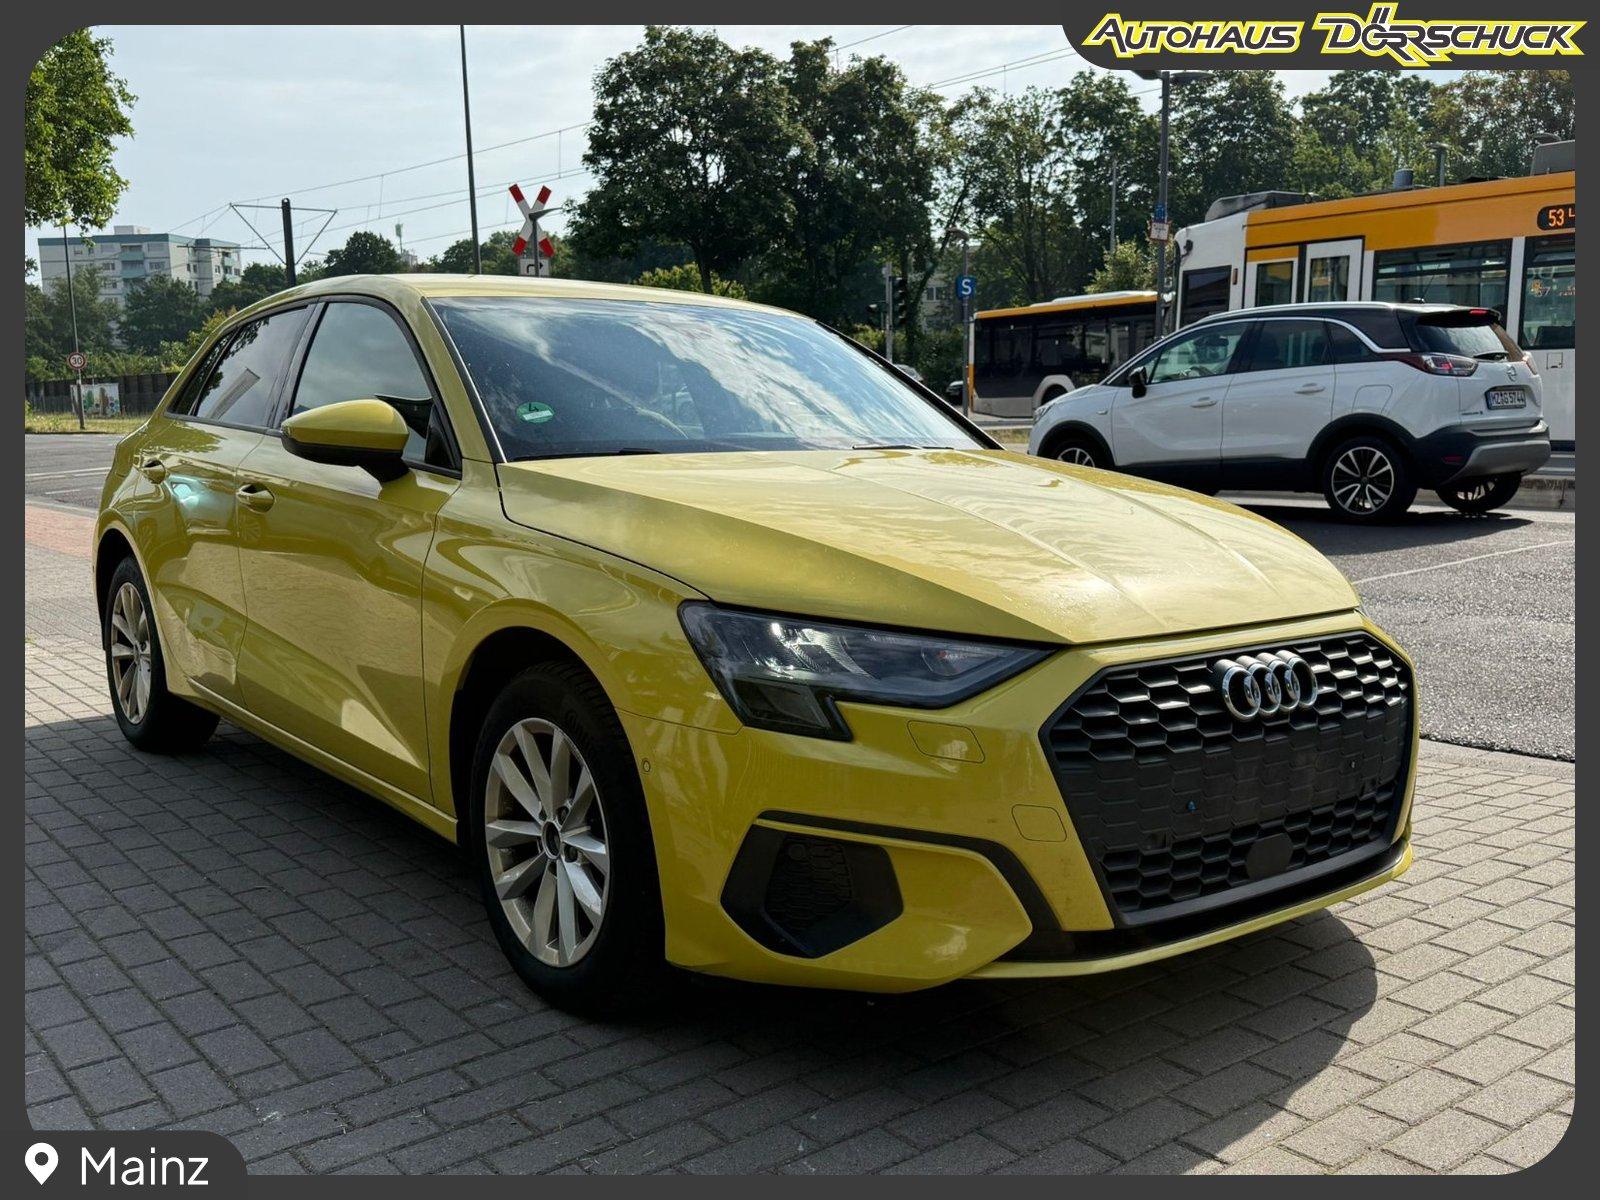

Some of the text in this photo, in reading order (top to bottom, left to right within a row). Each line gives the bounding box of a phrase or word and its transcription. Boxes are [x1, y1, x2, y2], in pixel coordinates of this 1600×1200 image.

[1549, 209, 1565, 227] 53
[961, 279, 972, 295] S
[71, 356, 83, 365] 30
